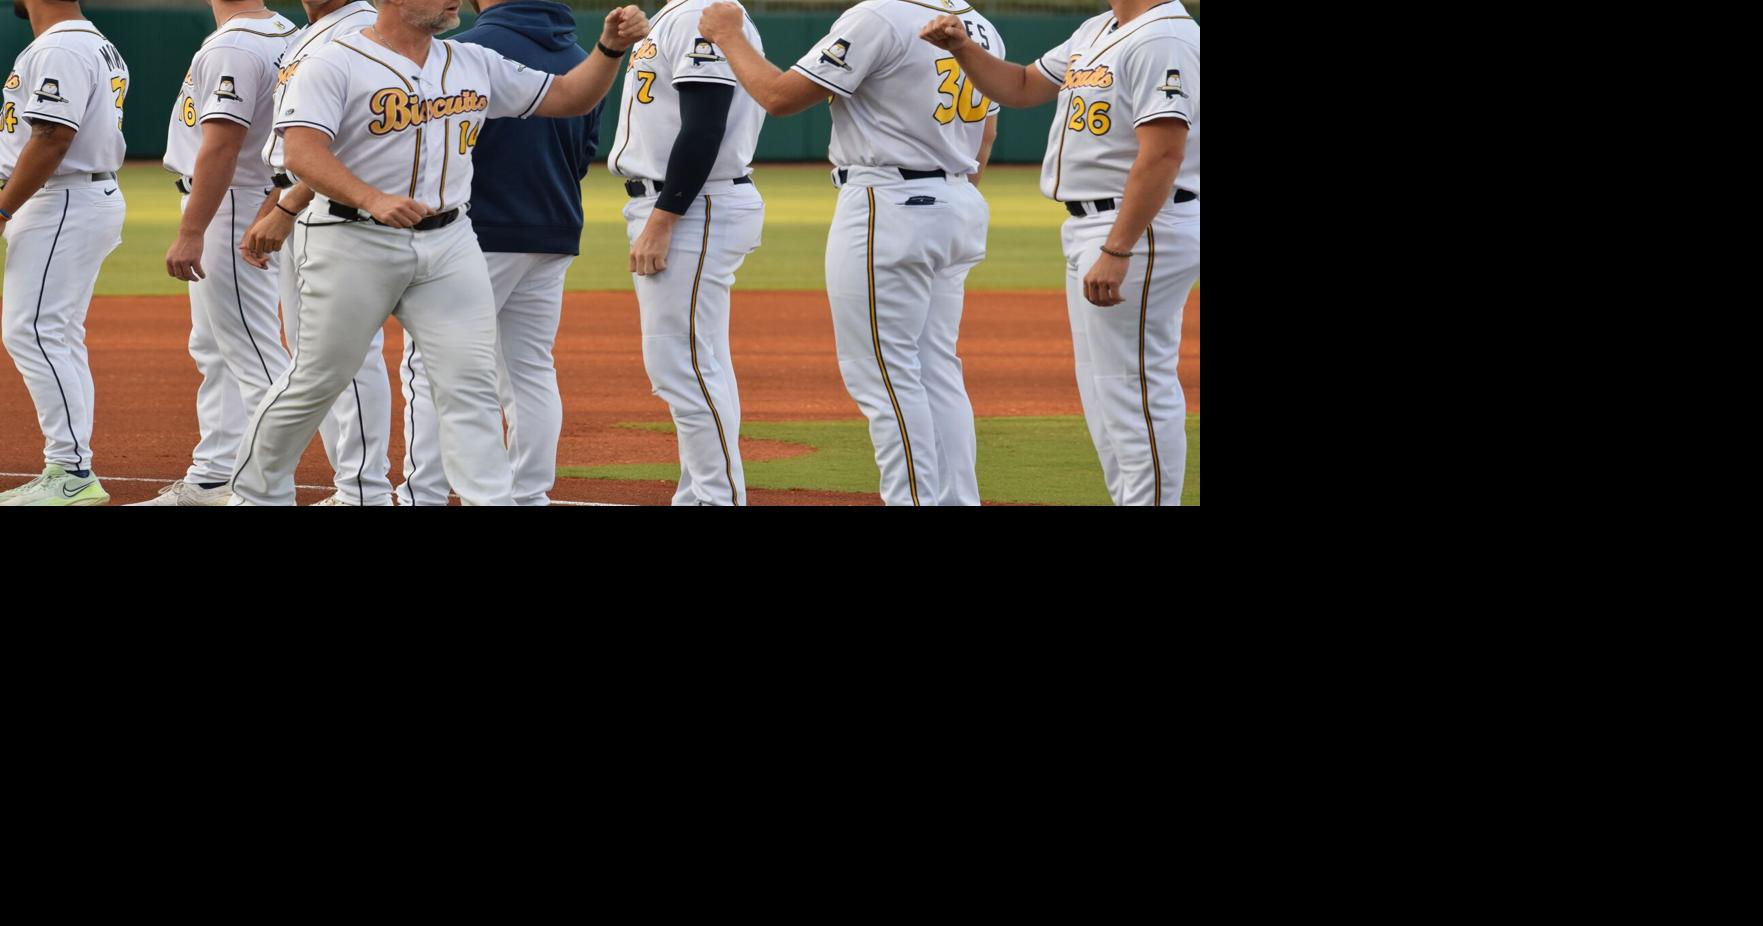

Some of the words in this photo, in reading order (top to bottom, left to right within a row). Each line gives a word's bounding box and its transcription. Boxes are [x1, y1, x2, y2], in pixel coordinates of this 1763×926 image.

[637, 70, 657, 104] 7
[933, 57, 991, 125] 30
[0, 102, 18, 133] 4
[368, 87, 488, 135] Biscuits
[1068, 95, 1112, 136] 26
